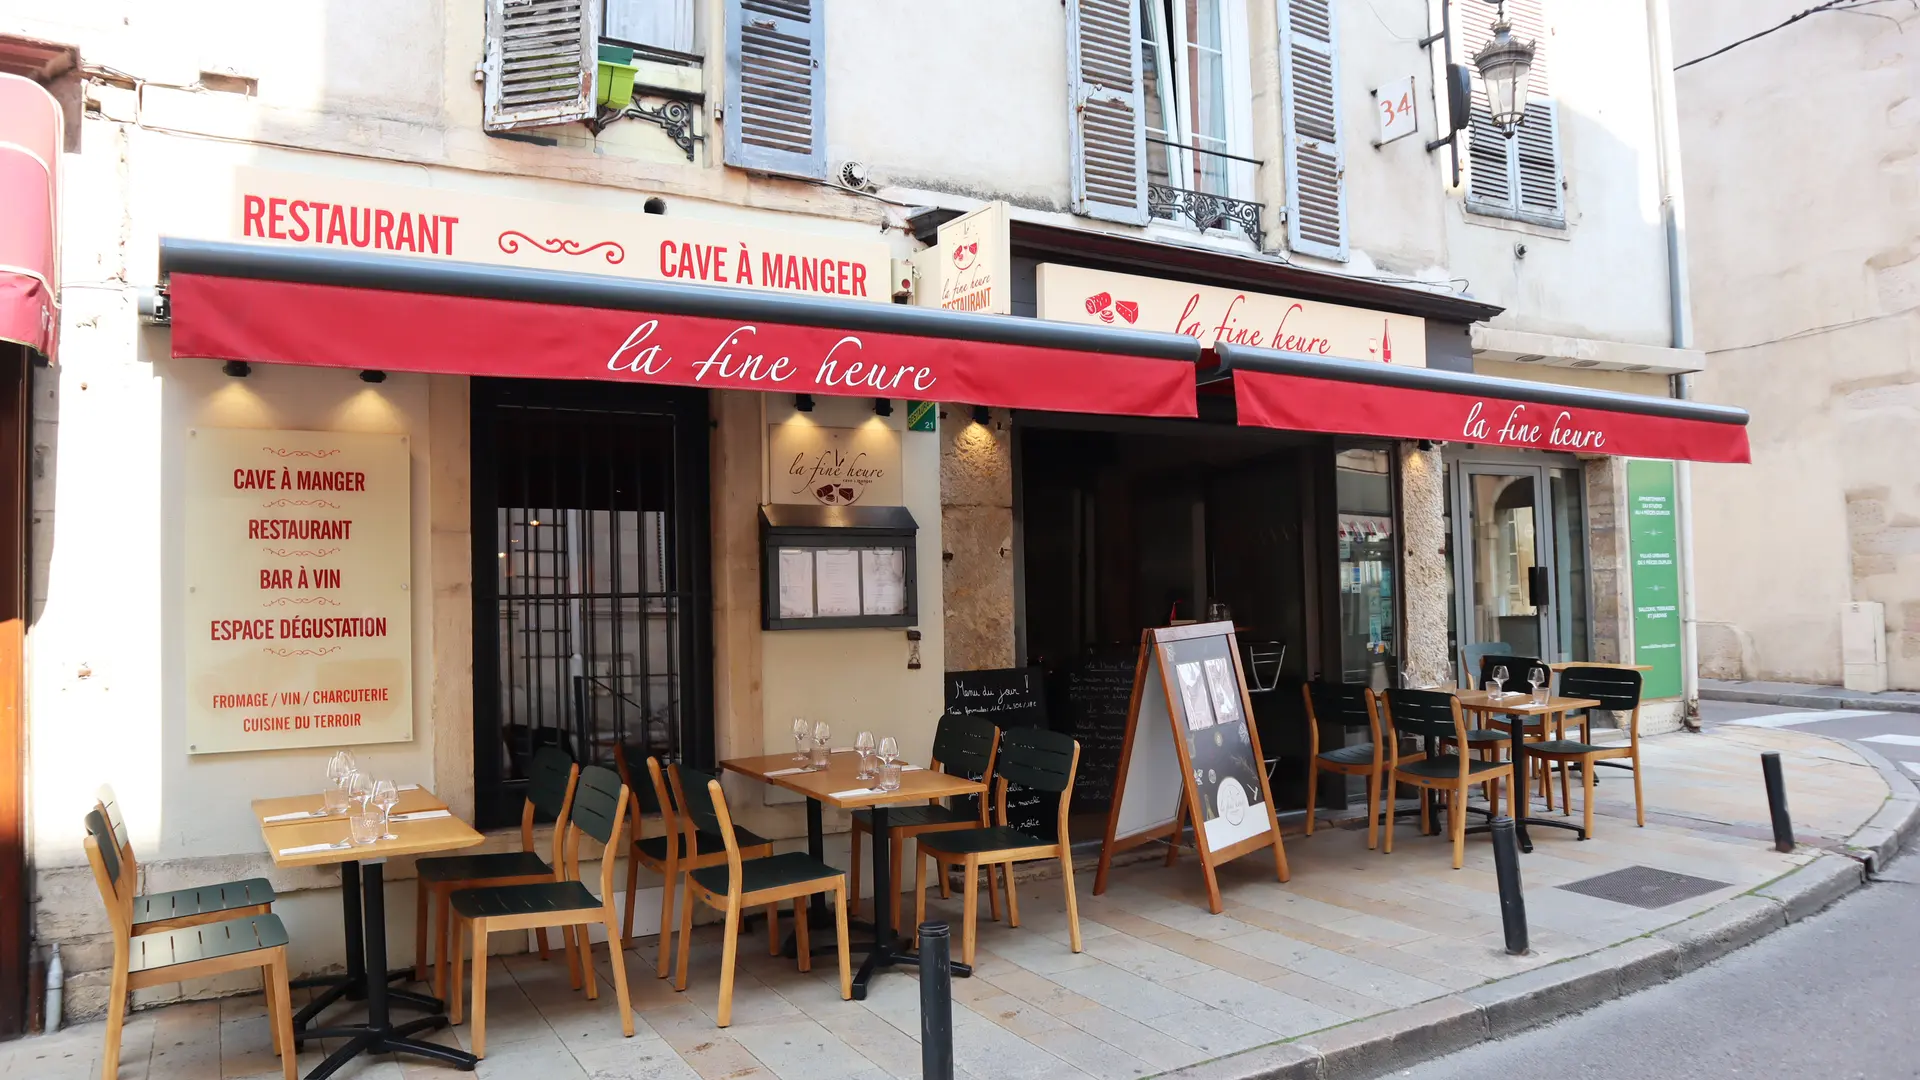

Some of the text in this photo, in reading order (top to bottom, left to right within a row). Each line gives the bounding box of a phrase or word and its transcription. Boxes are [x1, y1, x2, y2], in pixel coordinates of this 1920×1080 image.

[1380, 92, 1412, 127] 34
[244, 195, 459, 256] RESTAURANT
[660, 240, 867, 297] CAVE À MANGER
[1175, 293, 1331, 354] la fine heure
[607, 319, 937, 391] la fine heure
[924, 421, 934, 429] 21
[1463, 401, 1606, 448] la fine heure
[233, 467, 365, 493] CAVE À MANGER
[788, 448, 885, 495] la fine heure
[248, 518, 353, 541] RESTAURANT
[260, 565, 341, 590] BAR À VIN
[211, 616, 387, 641] ESPACE DÉGUSTATION
[213, 692, 268, 709] FROMAGE
[281, 691, 300, 706] VIN
[313, 687, 389, 705] CHARCUTERIE
[955, 680, 980, 699] Menu
[982, 685, 995, 697] du
[997, 687, 1020, 705] jour
[243, 713, 361, 732] CUISINE DU TERROIR
